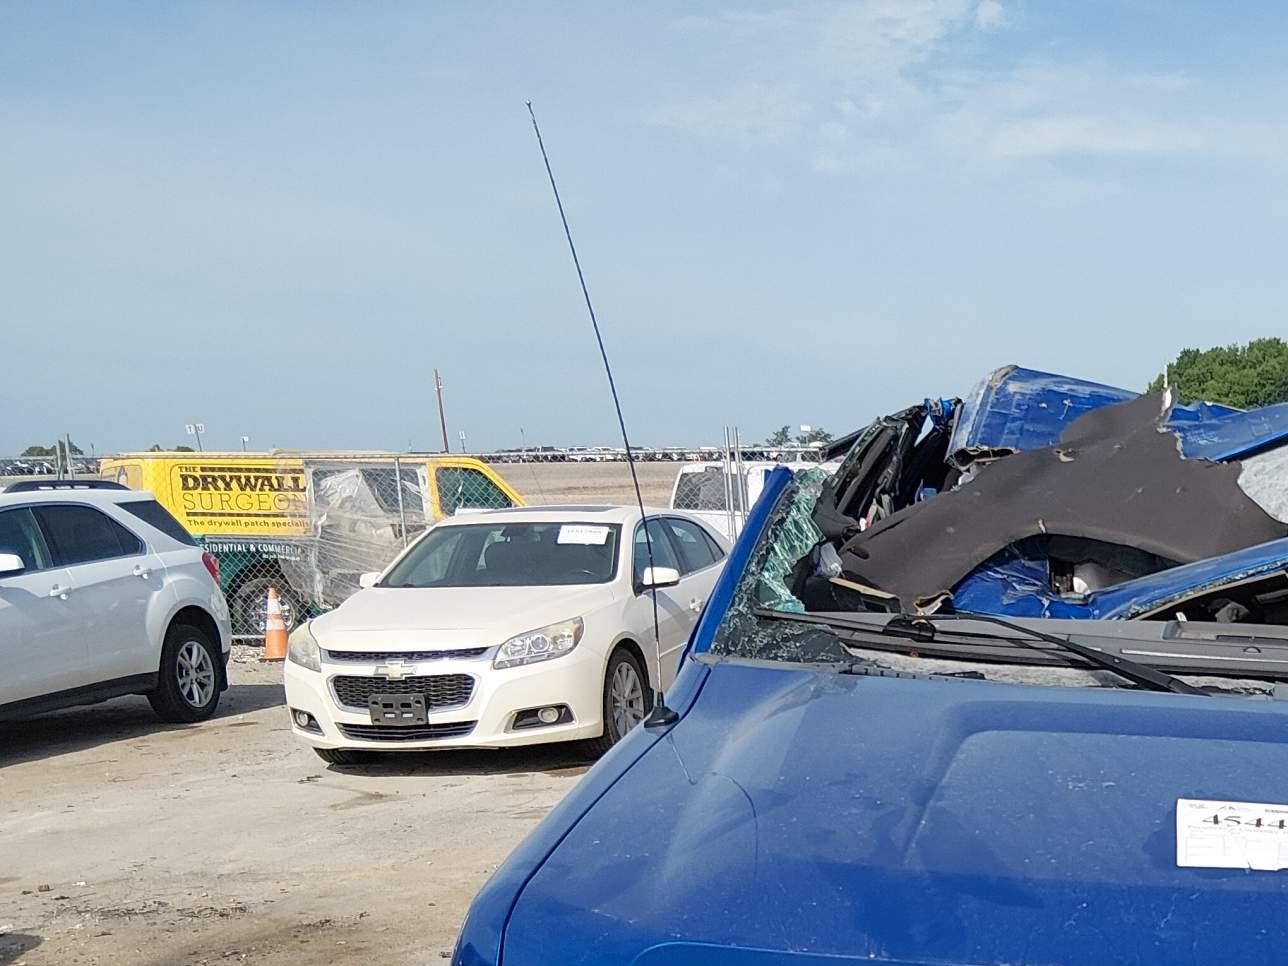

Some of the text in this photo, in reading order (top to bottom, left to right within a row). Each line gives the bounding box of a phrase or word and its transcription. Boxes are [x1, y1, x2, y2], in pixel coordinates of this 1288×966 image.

[180, 474, 307, 492] DRYWALL
[188, 519, 205, 527] The
[207, 519, 242, 528] drywall
[244, 520, 270, 528] patch
[200, 543, 303, 555] SIDENTIAL & COMMERCIA
